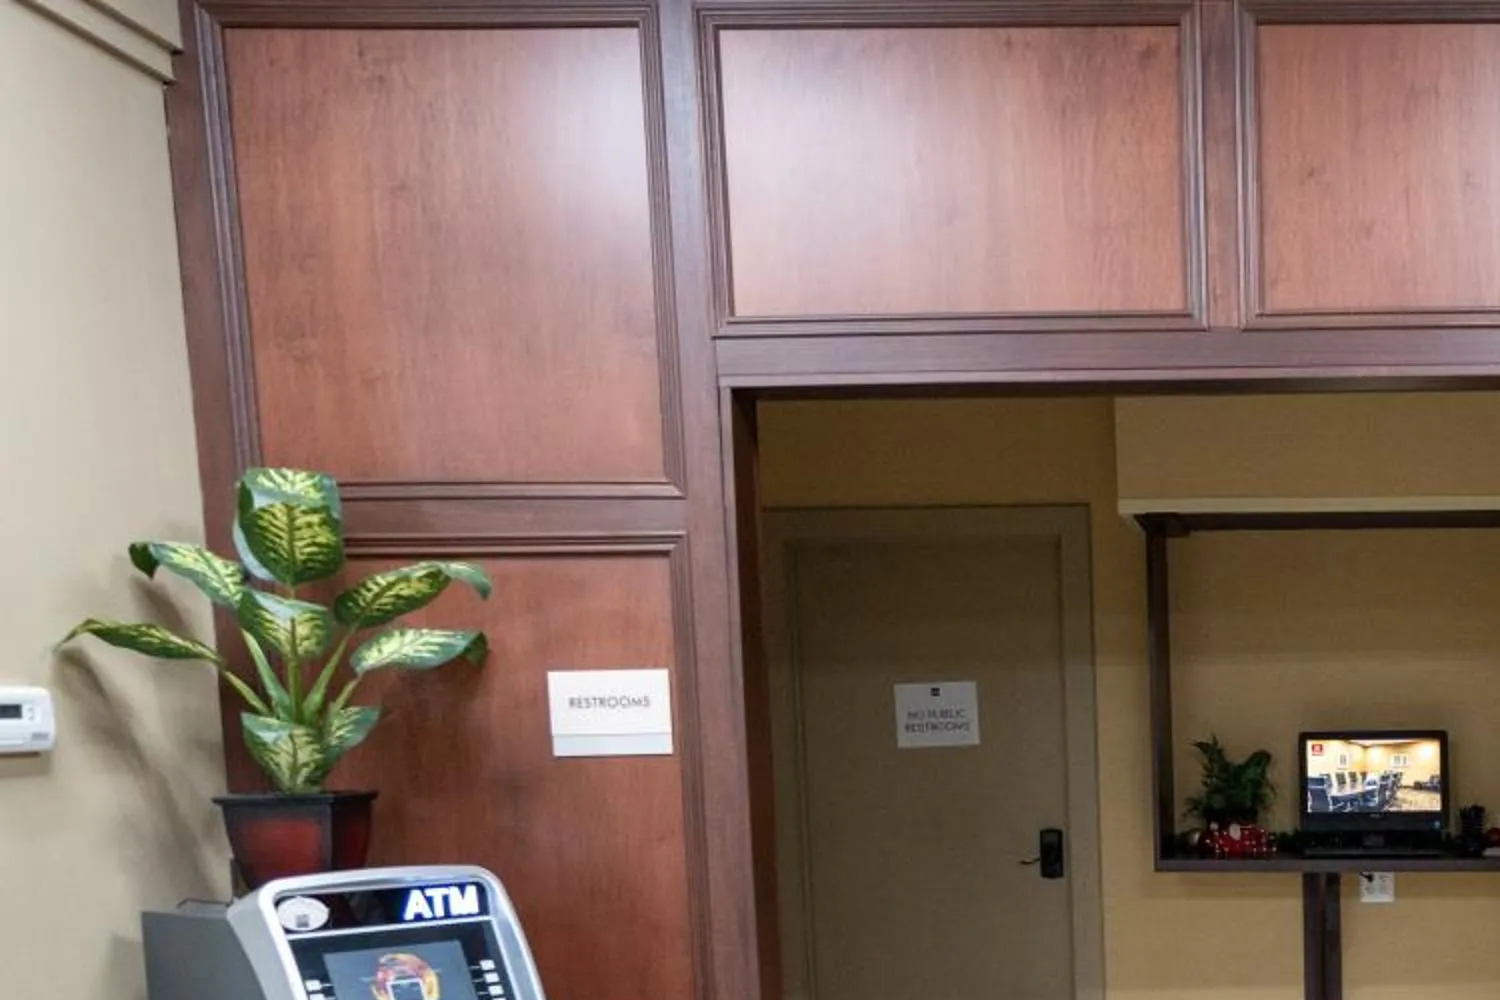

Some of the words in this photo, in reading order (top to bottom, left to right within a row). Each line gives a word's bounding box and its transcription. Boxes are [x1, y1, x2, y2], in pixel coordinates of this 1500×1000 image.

[568, 694, 652, 710] RESTROOMS
[904, 721, 970, 733] RESTROOMS
[403, 884, 479, 921] ATM
